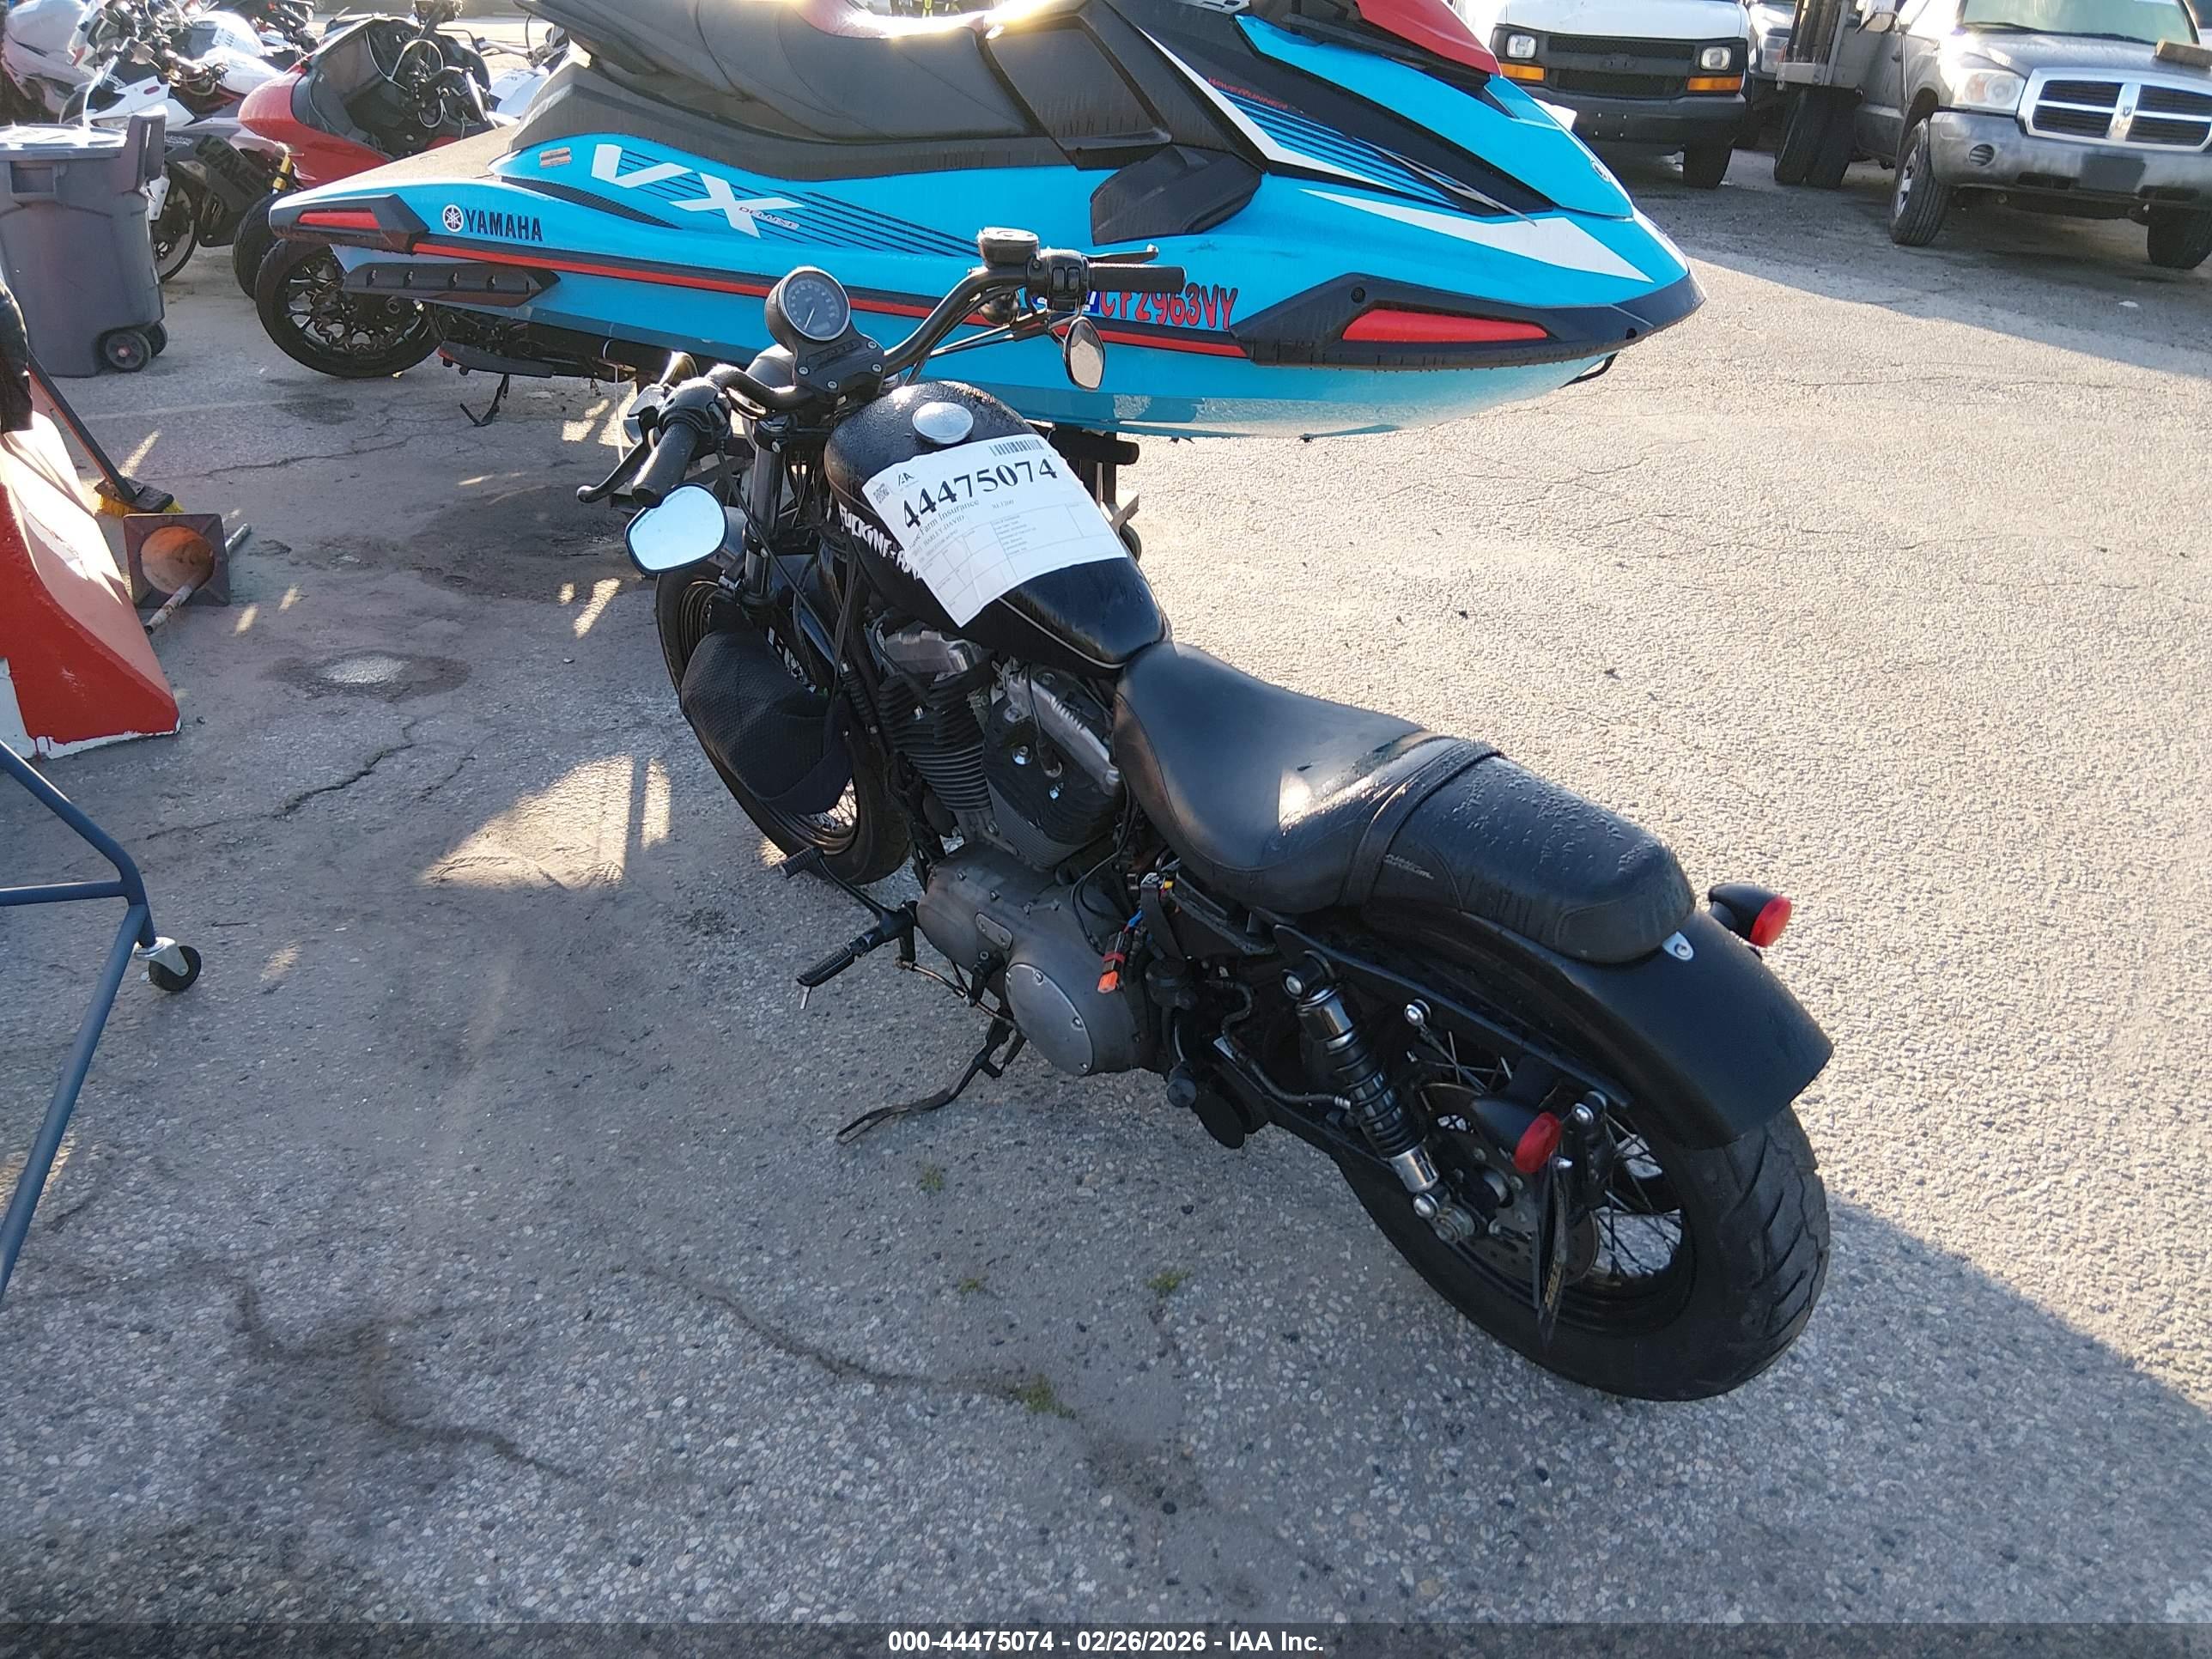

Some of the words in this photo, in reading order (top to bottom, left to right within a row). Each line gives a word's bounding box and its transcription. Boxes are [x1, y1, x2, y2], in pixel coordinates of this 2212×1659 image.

[591, 143, 805, 239] VX
[465, 208, 543, 241] YAMAHA
[903, 459, 1057, 528] 44475074
[920, 519, 939, 536] Farm
[938, 500, 979, 520] Insurance
